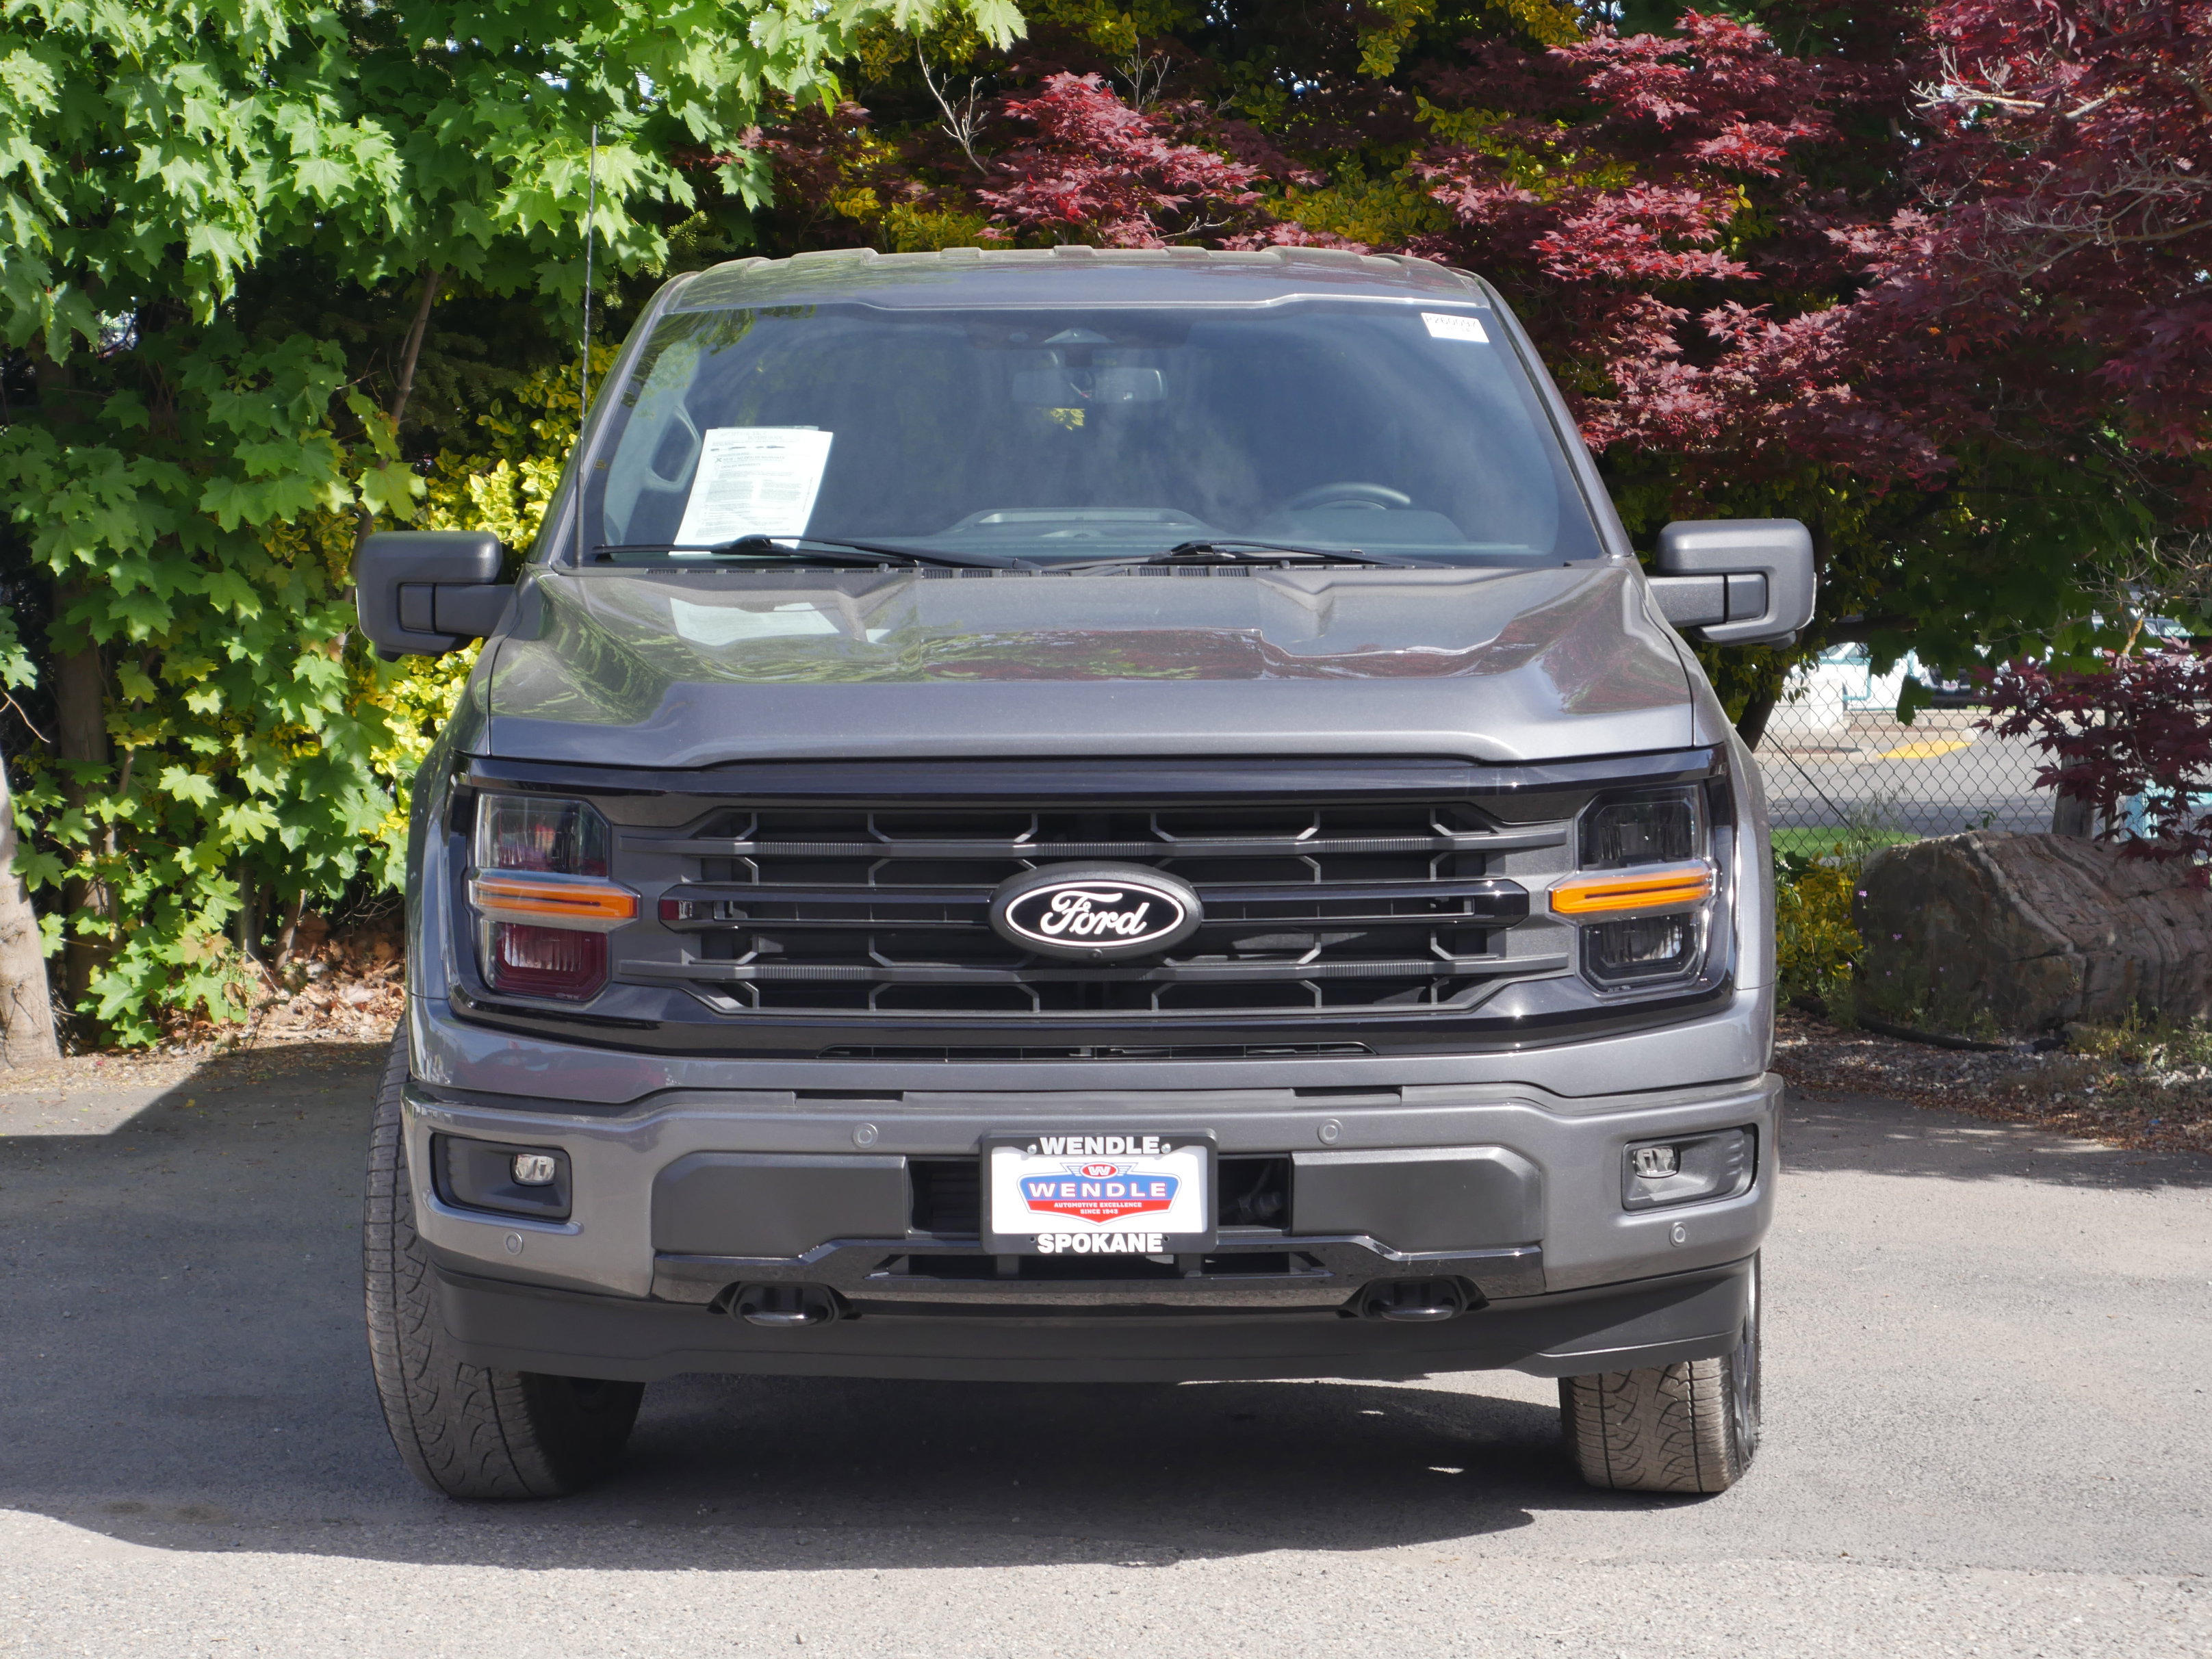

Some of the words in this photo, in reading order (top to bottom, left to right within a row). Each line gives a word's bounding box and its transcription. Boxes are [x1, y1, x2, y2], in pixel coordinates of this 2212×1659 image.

[1040, 890, 1150, 936] Ford
[1040, 1137, 1160, 1155] WENDLE
[1028, 1182, 1166, 1198] WENDLE
[1038, 1233, 1163, 1253] SPOKANE
